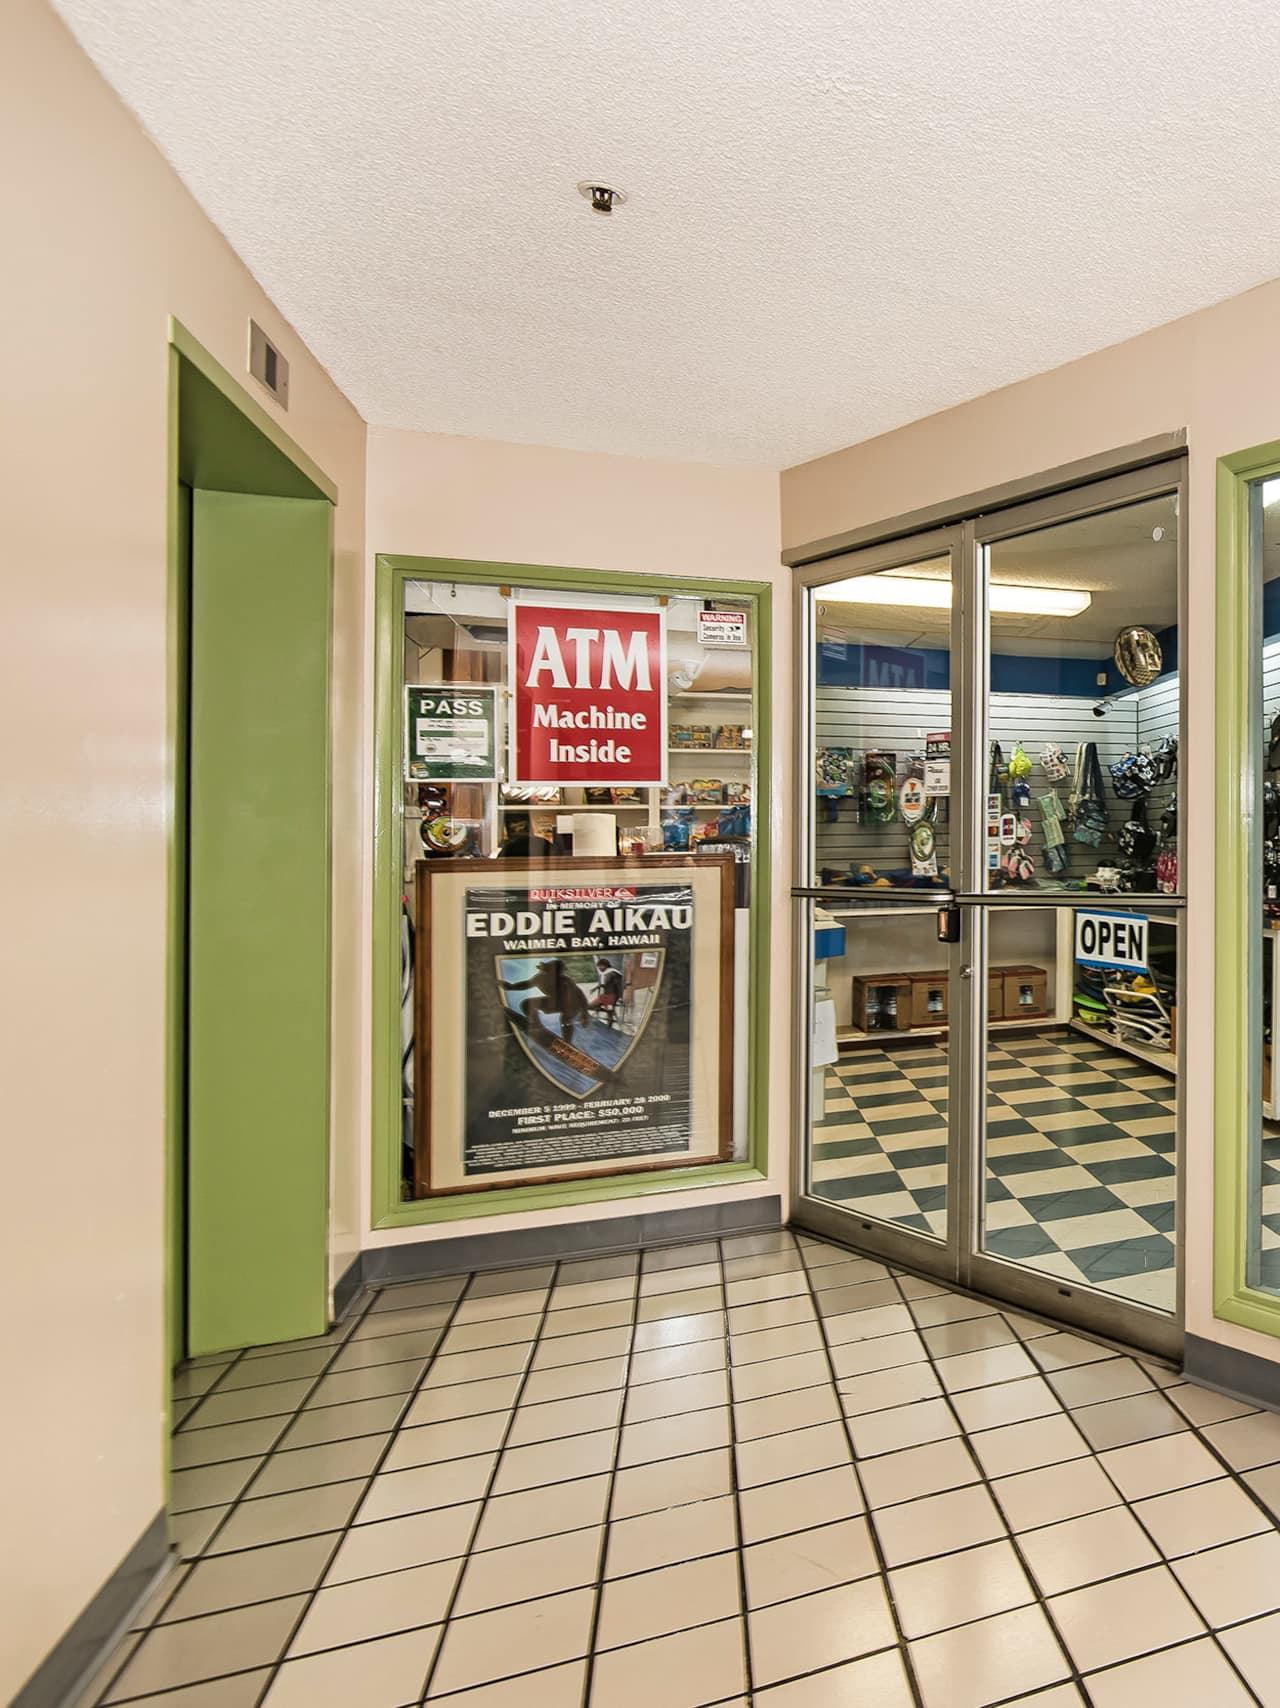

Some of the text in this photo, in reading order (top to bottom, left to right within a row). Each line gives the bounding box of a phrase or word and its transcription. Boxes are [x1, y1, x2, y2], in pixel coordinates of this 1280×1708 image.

[701, 613, 743, 622] WARNING
[525, 626, 654, 691] ATM
[420, 700, 484, 715] PASS
[532, 703, 648, 730] Machine
[549, 738, 632, 763] Inside
[530, 888, 613, 901] QUIKSILVER
[466, 905, 694, 938] EDDIE AIKAU
[503, 934, 660, 950] WAIMEA BAY, HAWAII
[1081, 919, 1144, 961] OPEN
[488, 1107, 542, 1118] DECEMBER
[583, 1098, 632, 1109] FEBRUARY
[518, 1114, 551, 1126] FIRST
[554, 1111, 596, 1123] PLACE:
